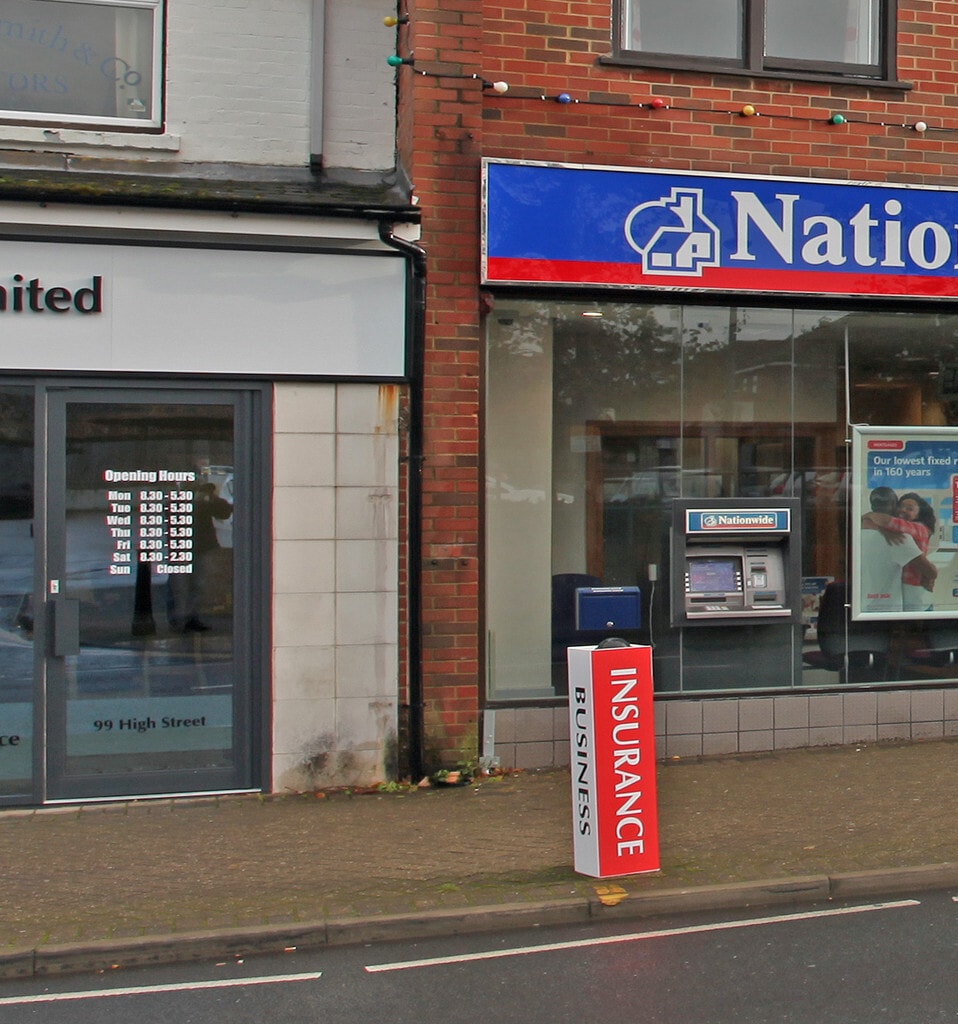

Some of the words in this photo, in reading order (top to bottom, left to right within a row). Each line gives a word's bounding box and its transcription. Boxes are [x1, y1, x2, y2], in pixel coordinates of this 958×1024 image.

[100, 57, 142, 90] Co.
[873, 456, 890, 465] Our
[894, 456, 925, 465] lowest
[927, 456, 951, 465] fixed
[104, 470, 157, 483] Opening
[158, 470, 195, 482] Hours
[873, 467, 883, 476] in
[886, 467, 903, 476] 160
[905, 468, 931, 478] years
[108, 491, 131, 501] Mon
[140, 491, 163, 501] 8.30
[170, 491, 193, 501] 5.30
[111, 503, 131, 513] Tue
[140, 503, 163, 513] 8.30
[170, 503, 193, 513] 5.30
[106, 515, 131, 525] Wed
[140, 515, 163, 525] 8.30
[170, 515, 193, 525] 5.30
[718, 515, 775, 525] Nationwide
[110, 528, 130, 537] Thu
[140, 528, 163, 537] 8.30
[170, 528, 193, 537] 5.30
[116, 540, 130, 550] Fri
[140, 540, 163, 550] 8.30
[170, 540, 193, 550] 5.30
[112, 552, 130, 562] Sat
[140, 552, 163, 562] 8.30
[170, 552, 193, 562] 2.30
[110, 564, 130, 574] Sun
[156, 564, 193, 574] Closed
[93, 719, 113, 731] 99
[119, 718, 156, 732] High
[161, 716, 206, 728] Street
[574, 686, 591, 836] BUSINESS
[610, 667, 645, 857] INSURANCE
